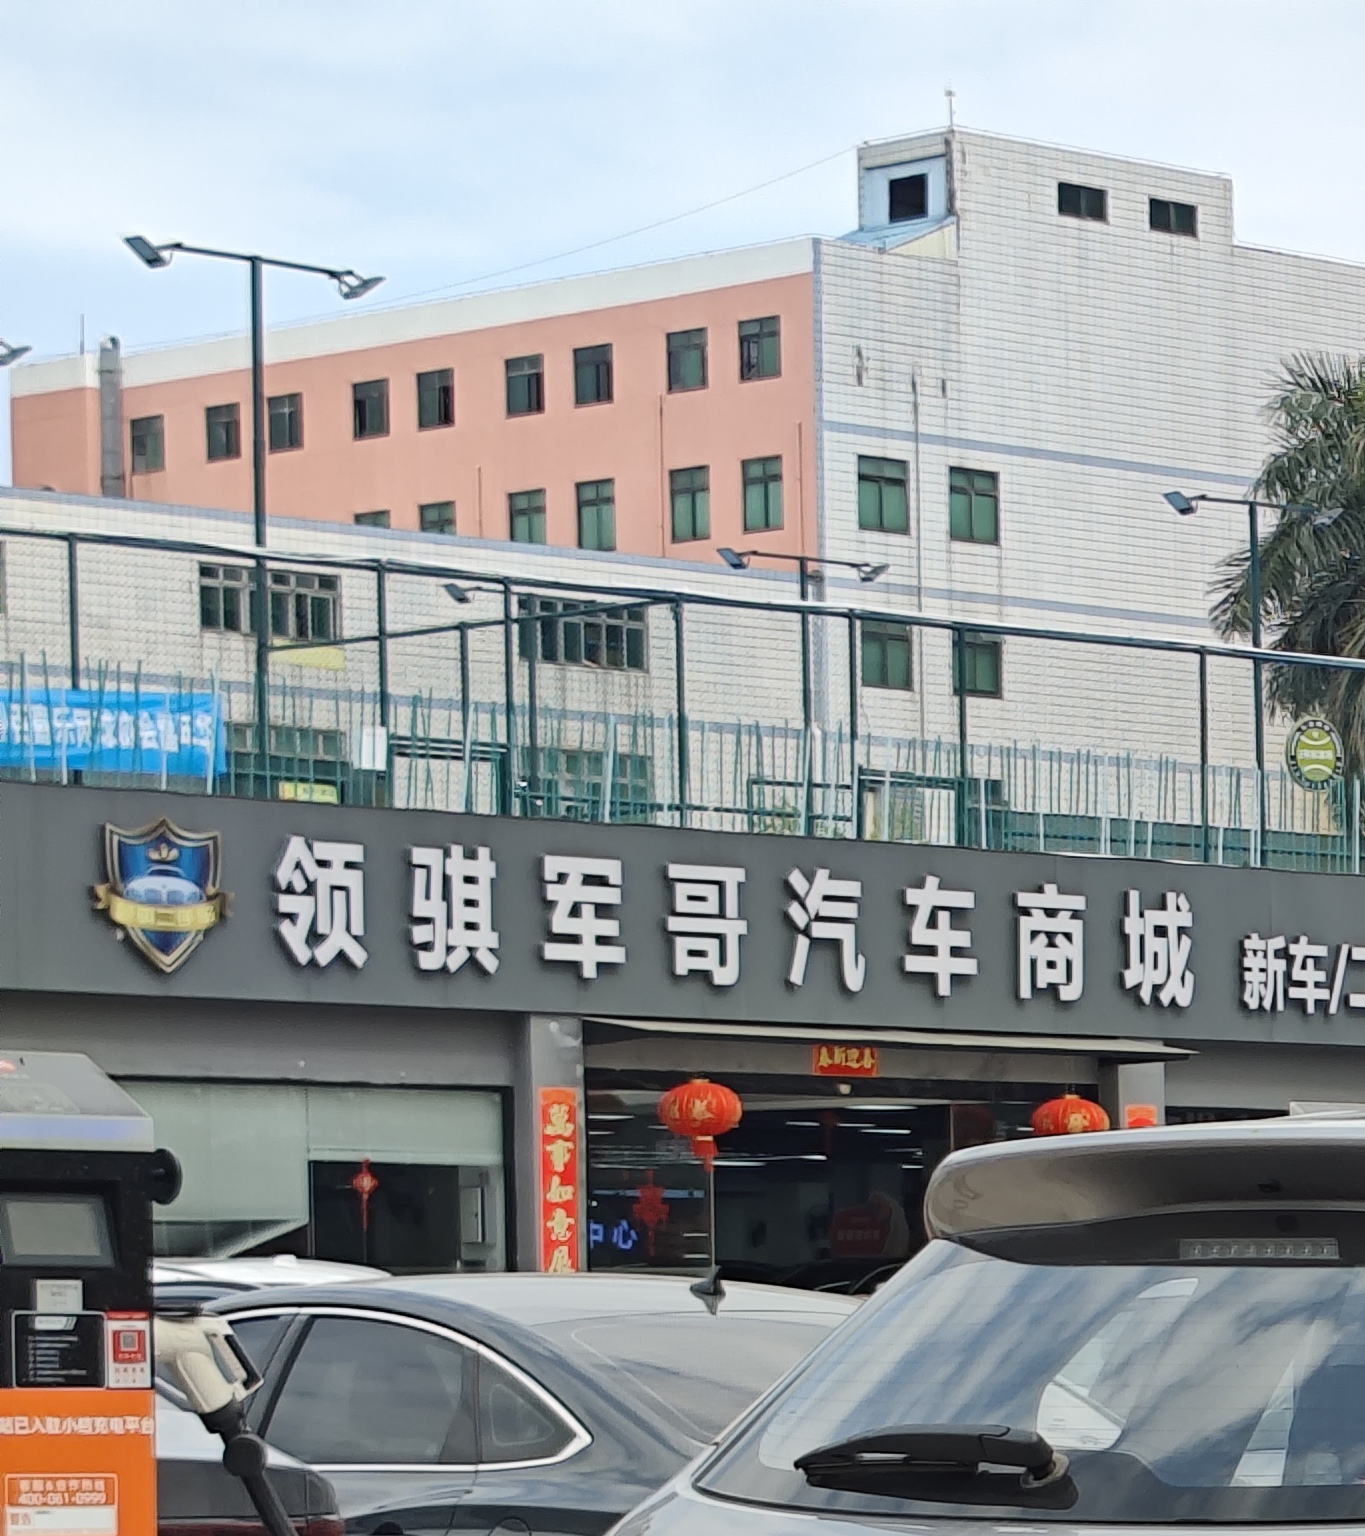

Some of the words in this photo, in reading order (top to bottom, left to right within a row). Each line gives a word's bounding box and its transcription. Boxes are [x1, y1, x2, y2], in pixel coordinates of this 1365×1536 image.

[274, 835, 1196, 1009] 领骐军哥汽车商城
